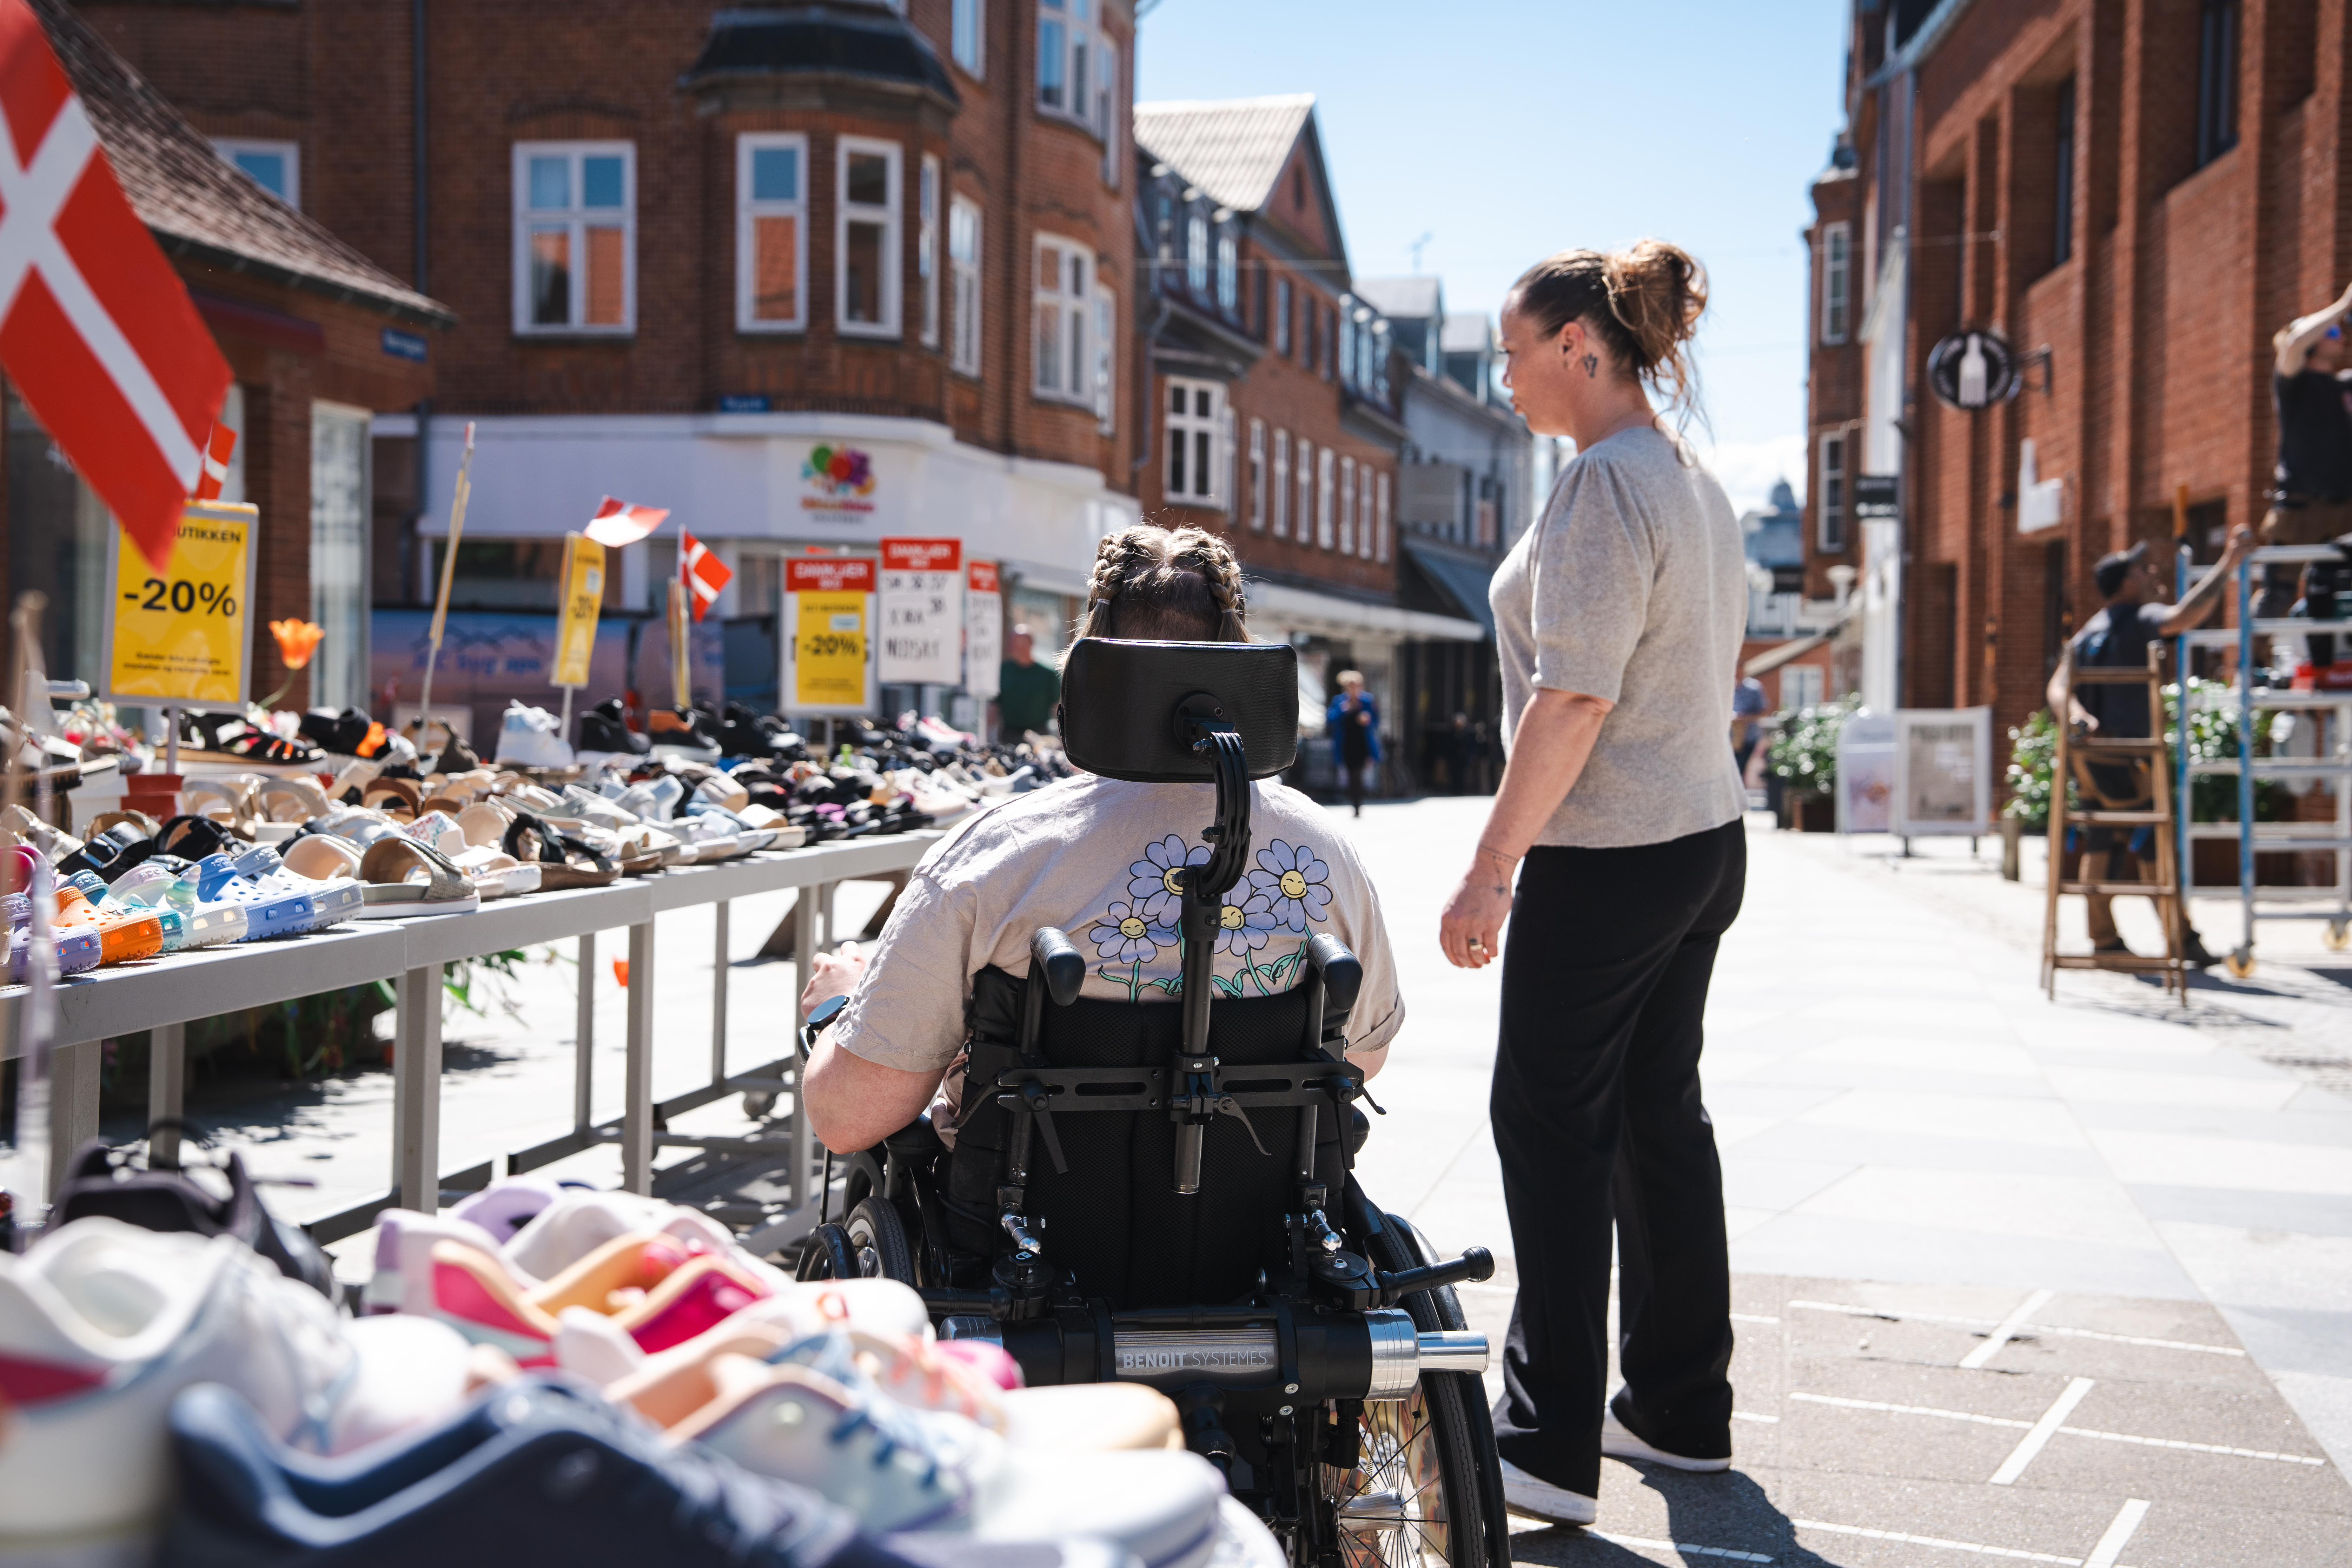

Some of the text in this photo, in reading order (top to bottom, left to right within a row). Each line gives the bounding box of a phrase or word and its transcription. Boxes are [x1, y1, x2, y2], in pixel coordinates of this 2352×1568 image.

[124, 577, 237, 617] -20%
[804, 635, 859, 655] -20%
[1123, 1350, 1267, 1368] BENOIT SYSTEMES
